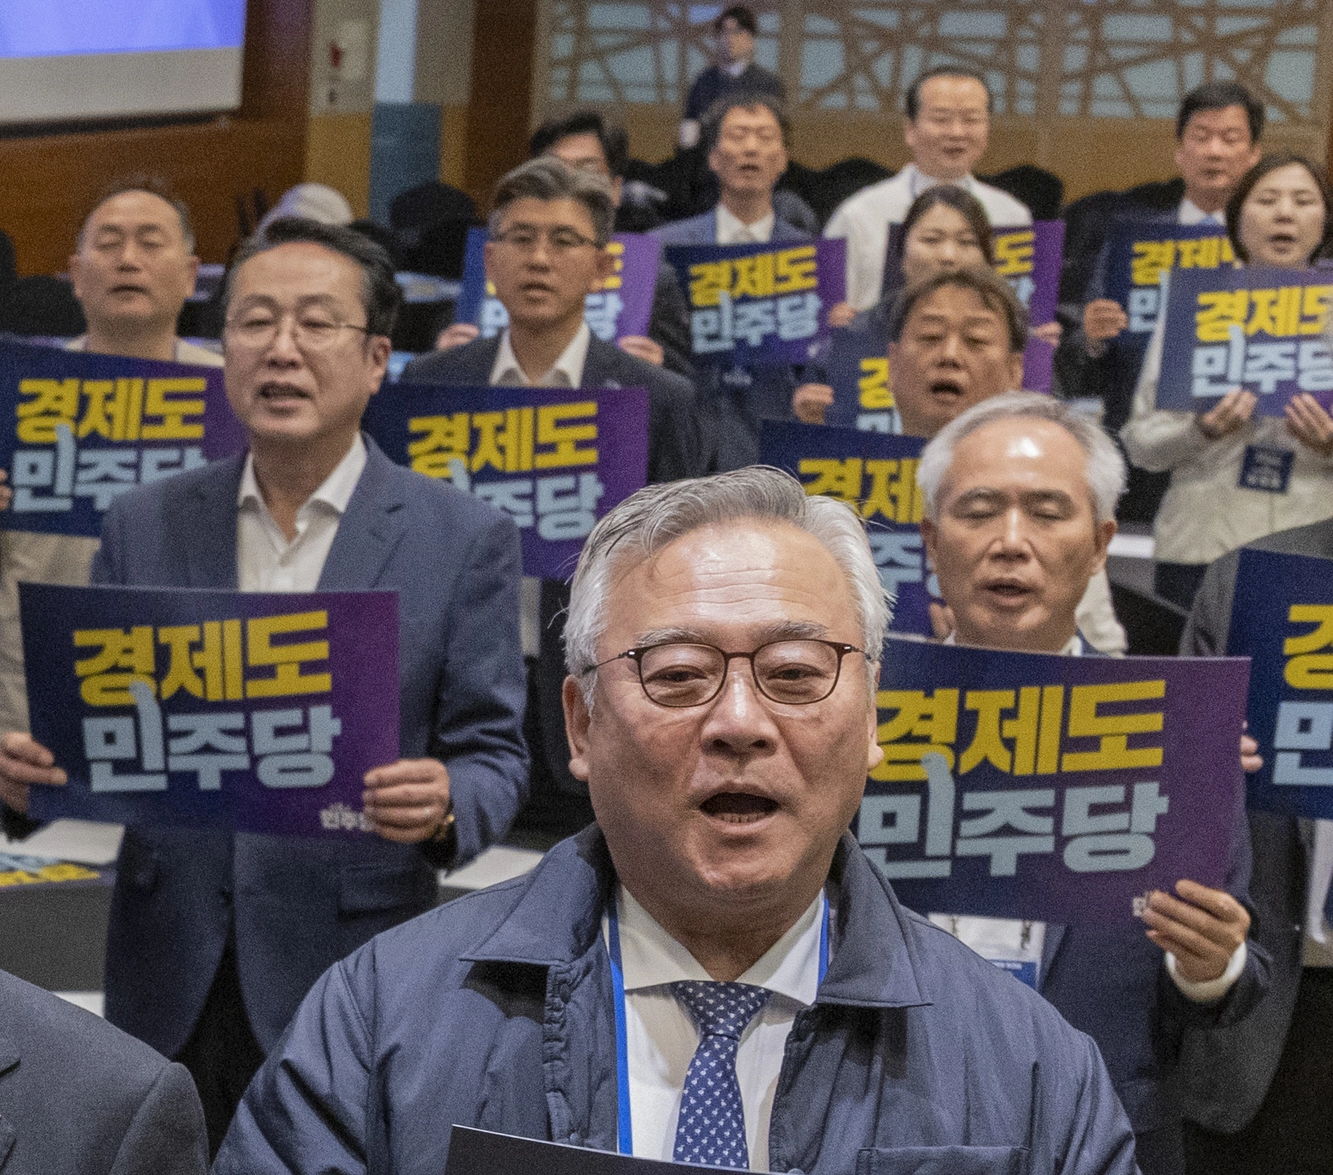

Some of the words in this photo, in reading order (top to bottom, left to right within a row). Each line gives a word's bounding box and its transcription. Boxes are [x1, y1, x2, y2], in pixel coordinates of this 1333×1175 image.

[689, 246, 818, 307] 경제도
[691, 290, 822, 355] 민주당
[16, 377, 208, 443] 경제도
[408, 401, 599, 480] 경제도
[73, 610, 332, 708] 경제도
[81, 681, 342, 792] 민주당
[867, 680, 1166, 782] 경제도
[857, 751, 1170, 881] 민주당
